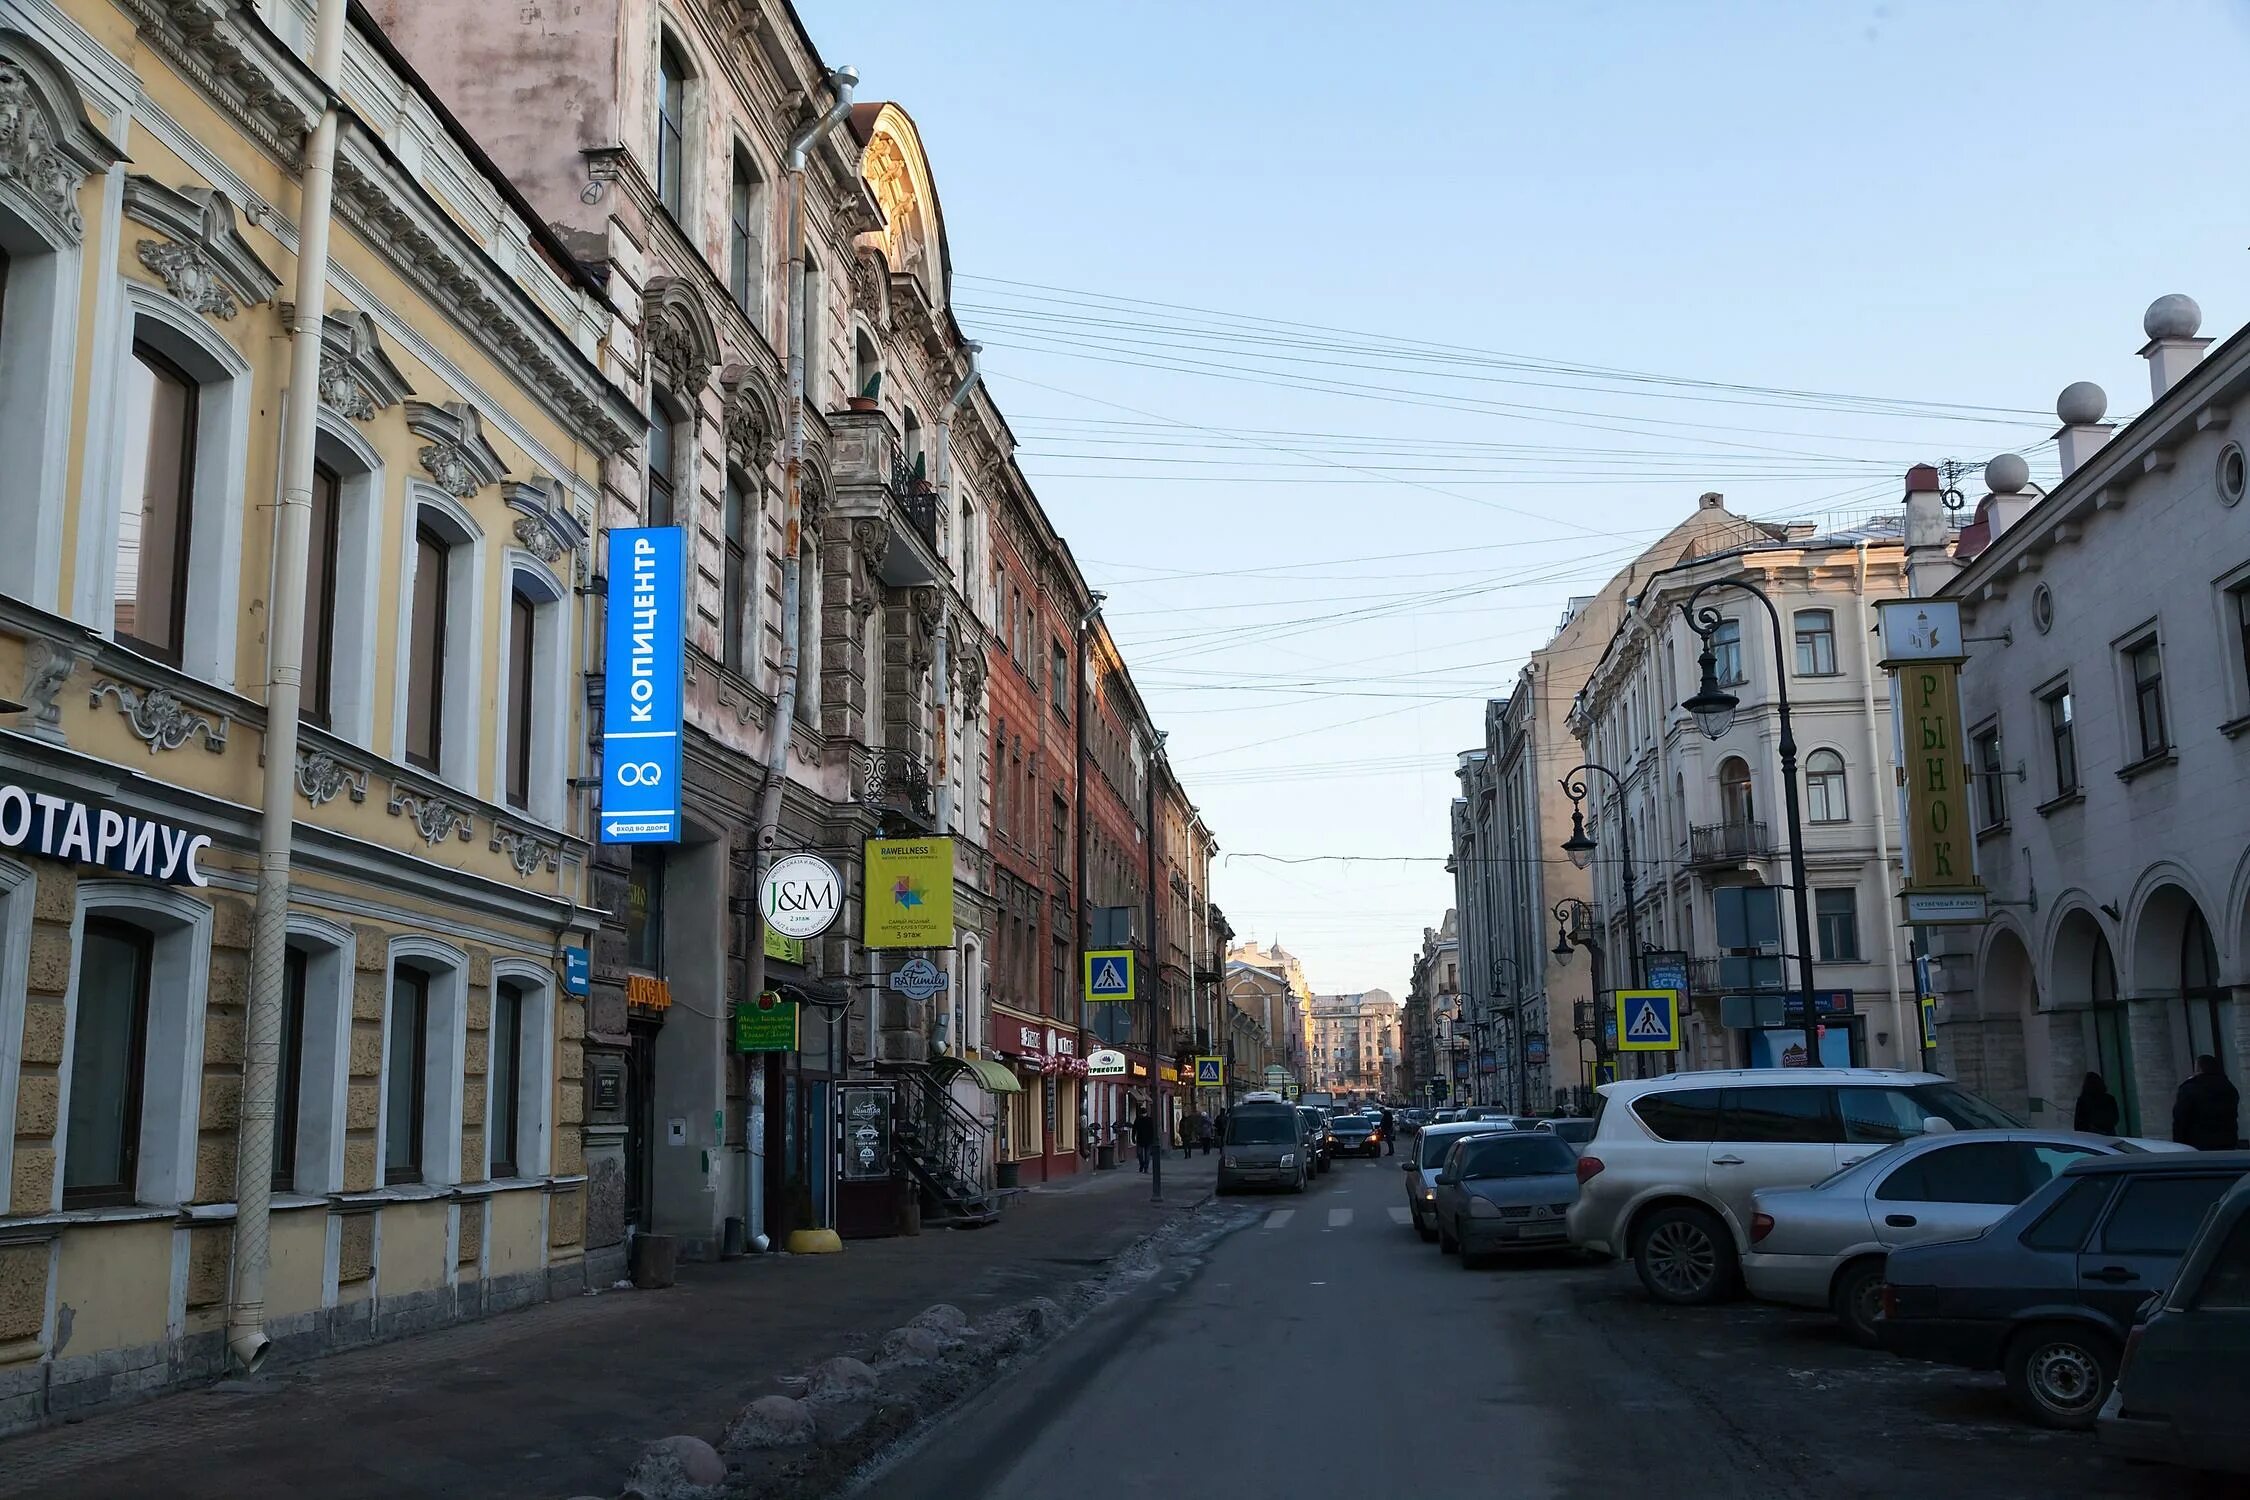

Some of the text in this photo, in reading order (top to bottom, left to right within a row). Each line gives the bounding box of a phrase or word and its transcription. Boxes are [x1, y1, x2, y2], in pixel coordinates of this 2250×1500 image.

[630, 537, 656, 722] КОПИЦЕНТР
[1920, 674, 1953, 877] РЫНОК
[0, 785, 212, 887] ОТАРИУС
[881, 846, 929, 855] RAWELLNESS
[768, 881, 835, 918] J&M
[903, 931, 922, 939] этаж
